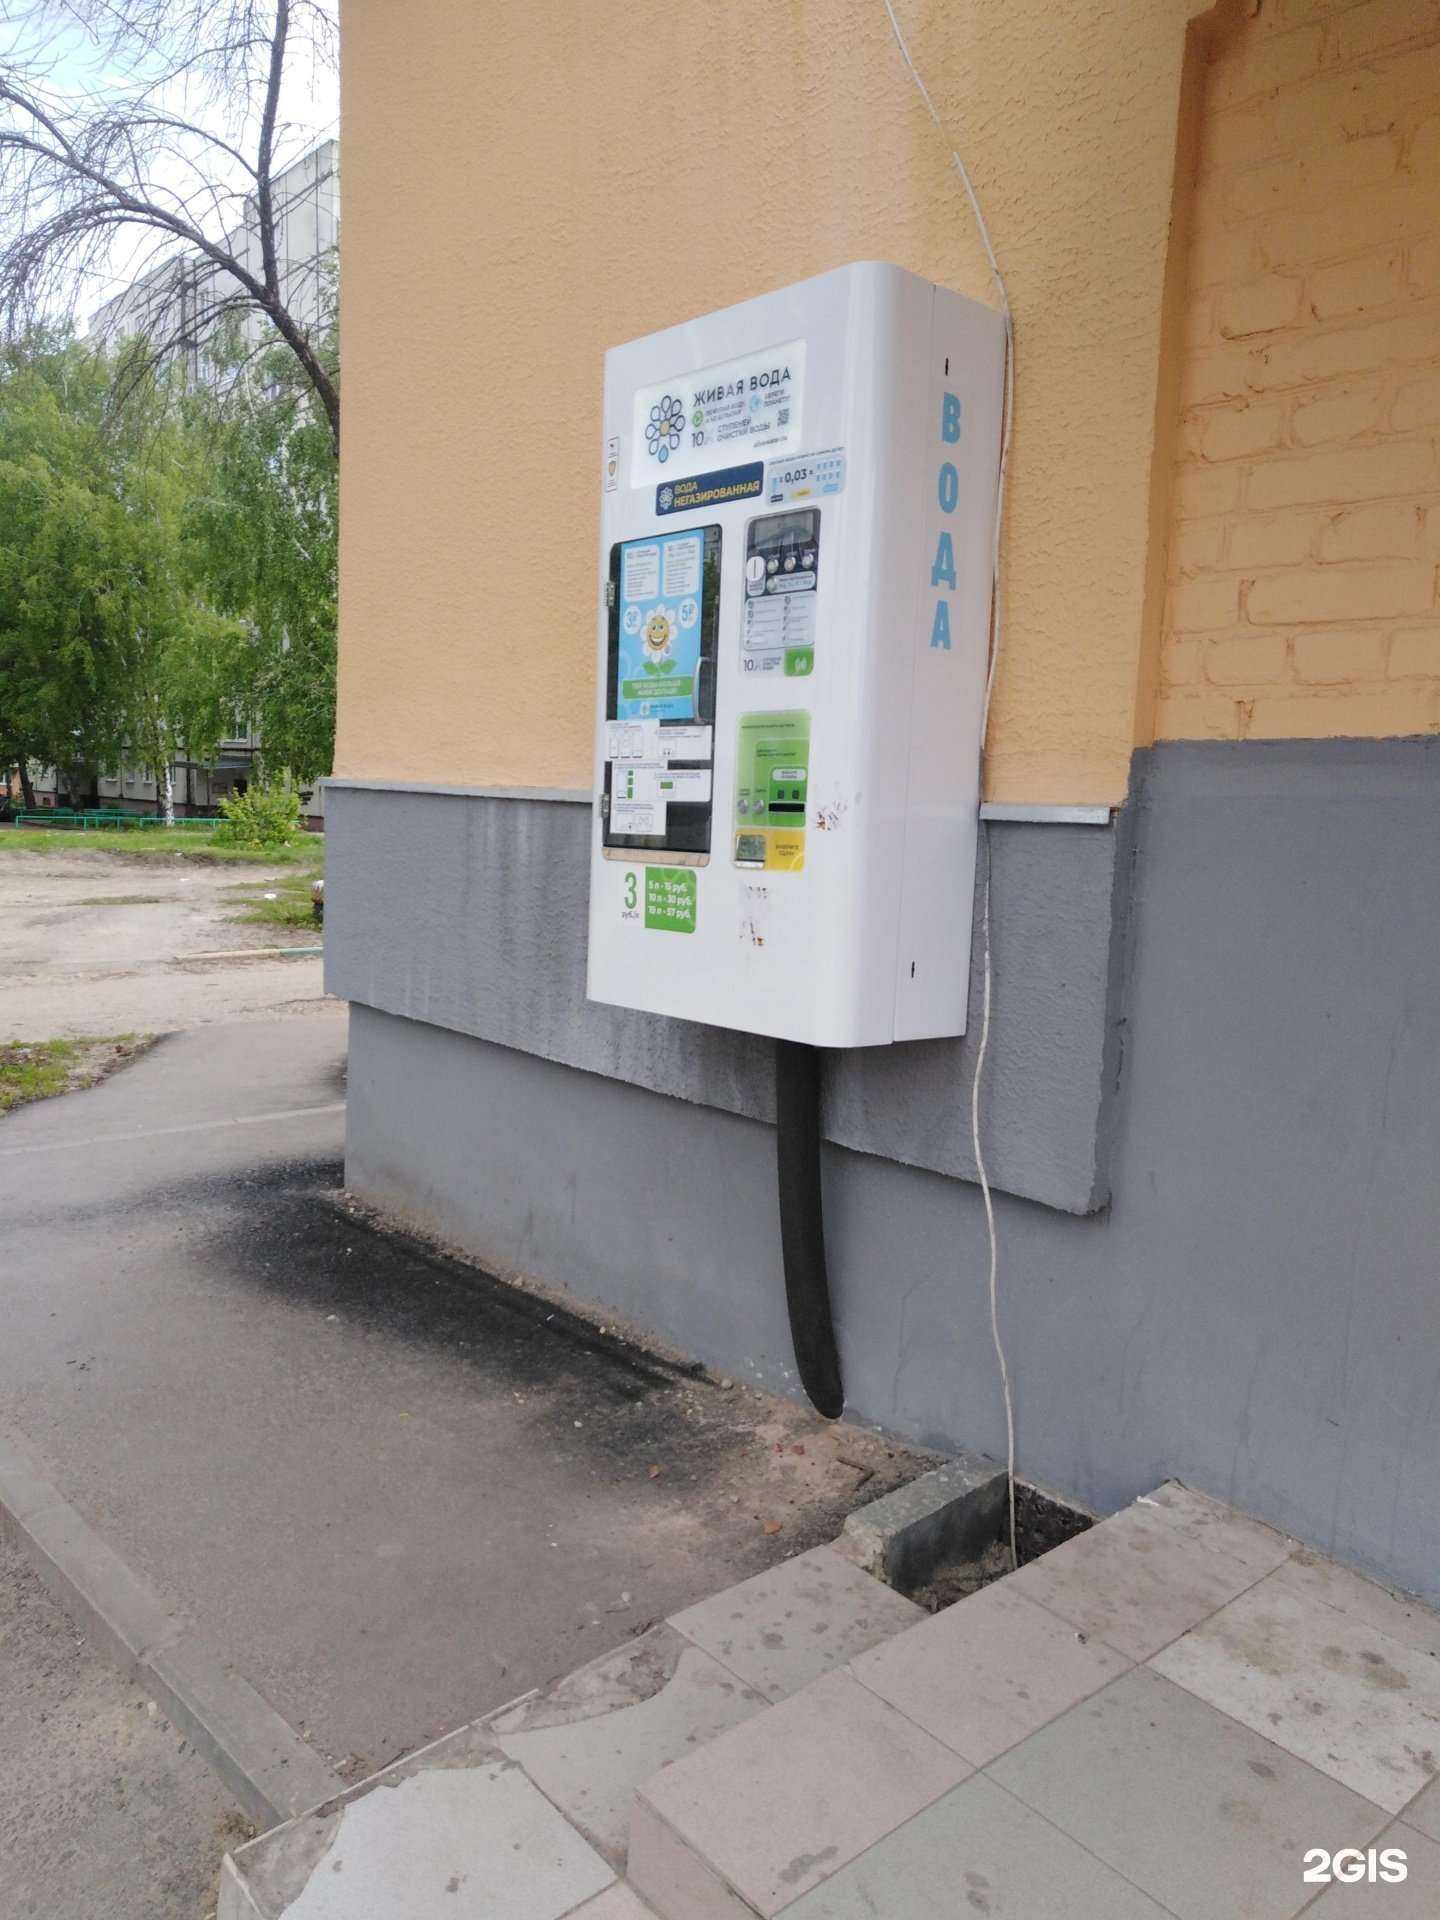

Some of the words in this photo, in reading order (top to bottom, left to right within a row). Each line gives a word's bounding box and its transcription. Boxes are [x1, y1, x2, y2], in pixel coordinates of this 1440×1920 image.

[693, 379, 744, 408] ЖИВАЯ
[749, 367, 791, 391] ВОДА
[692, 431, 704, 448] 10
[674, 481, 698, 495] ВОДА
[784, 468, 808, 485] 0,03
[673, 480, 760, 507] НЕГАЗИРОВАННАЯ
[930, 391, 961, 651] ВОДА
[624, 872, 637, 909] 3
